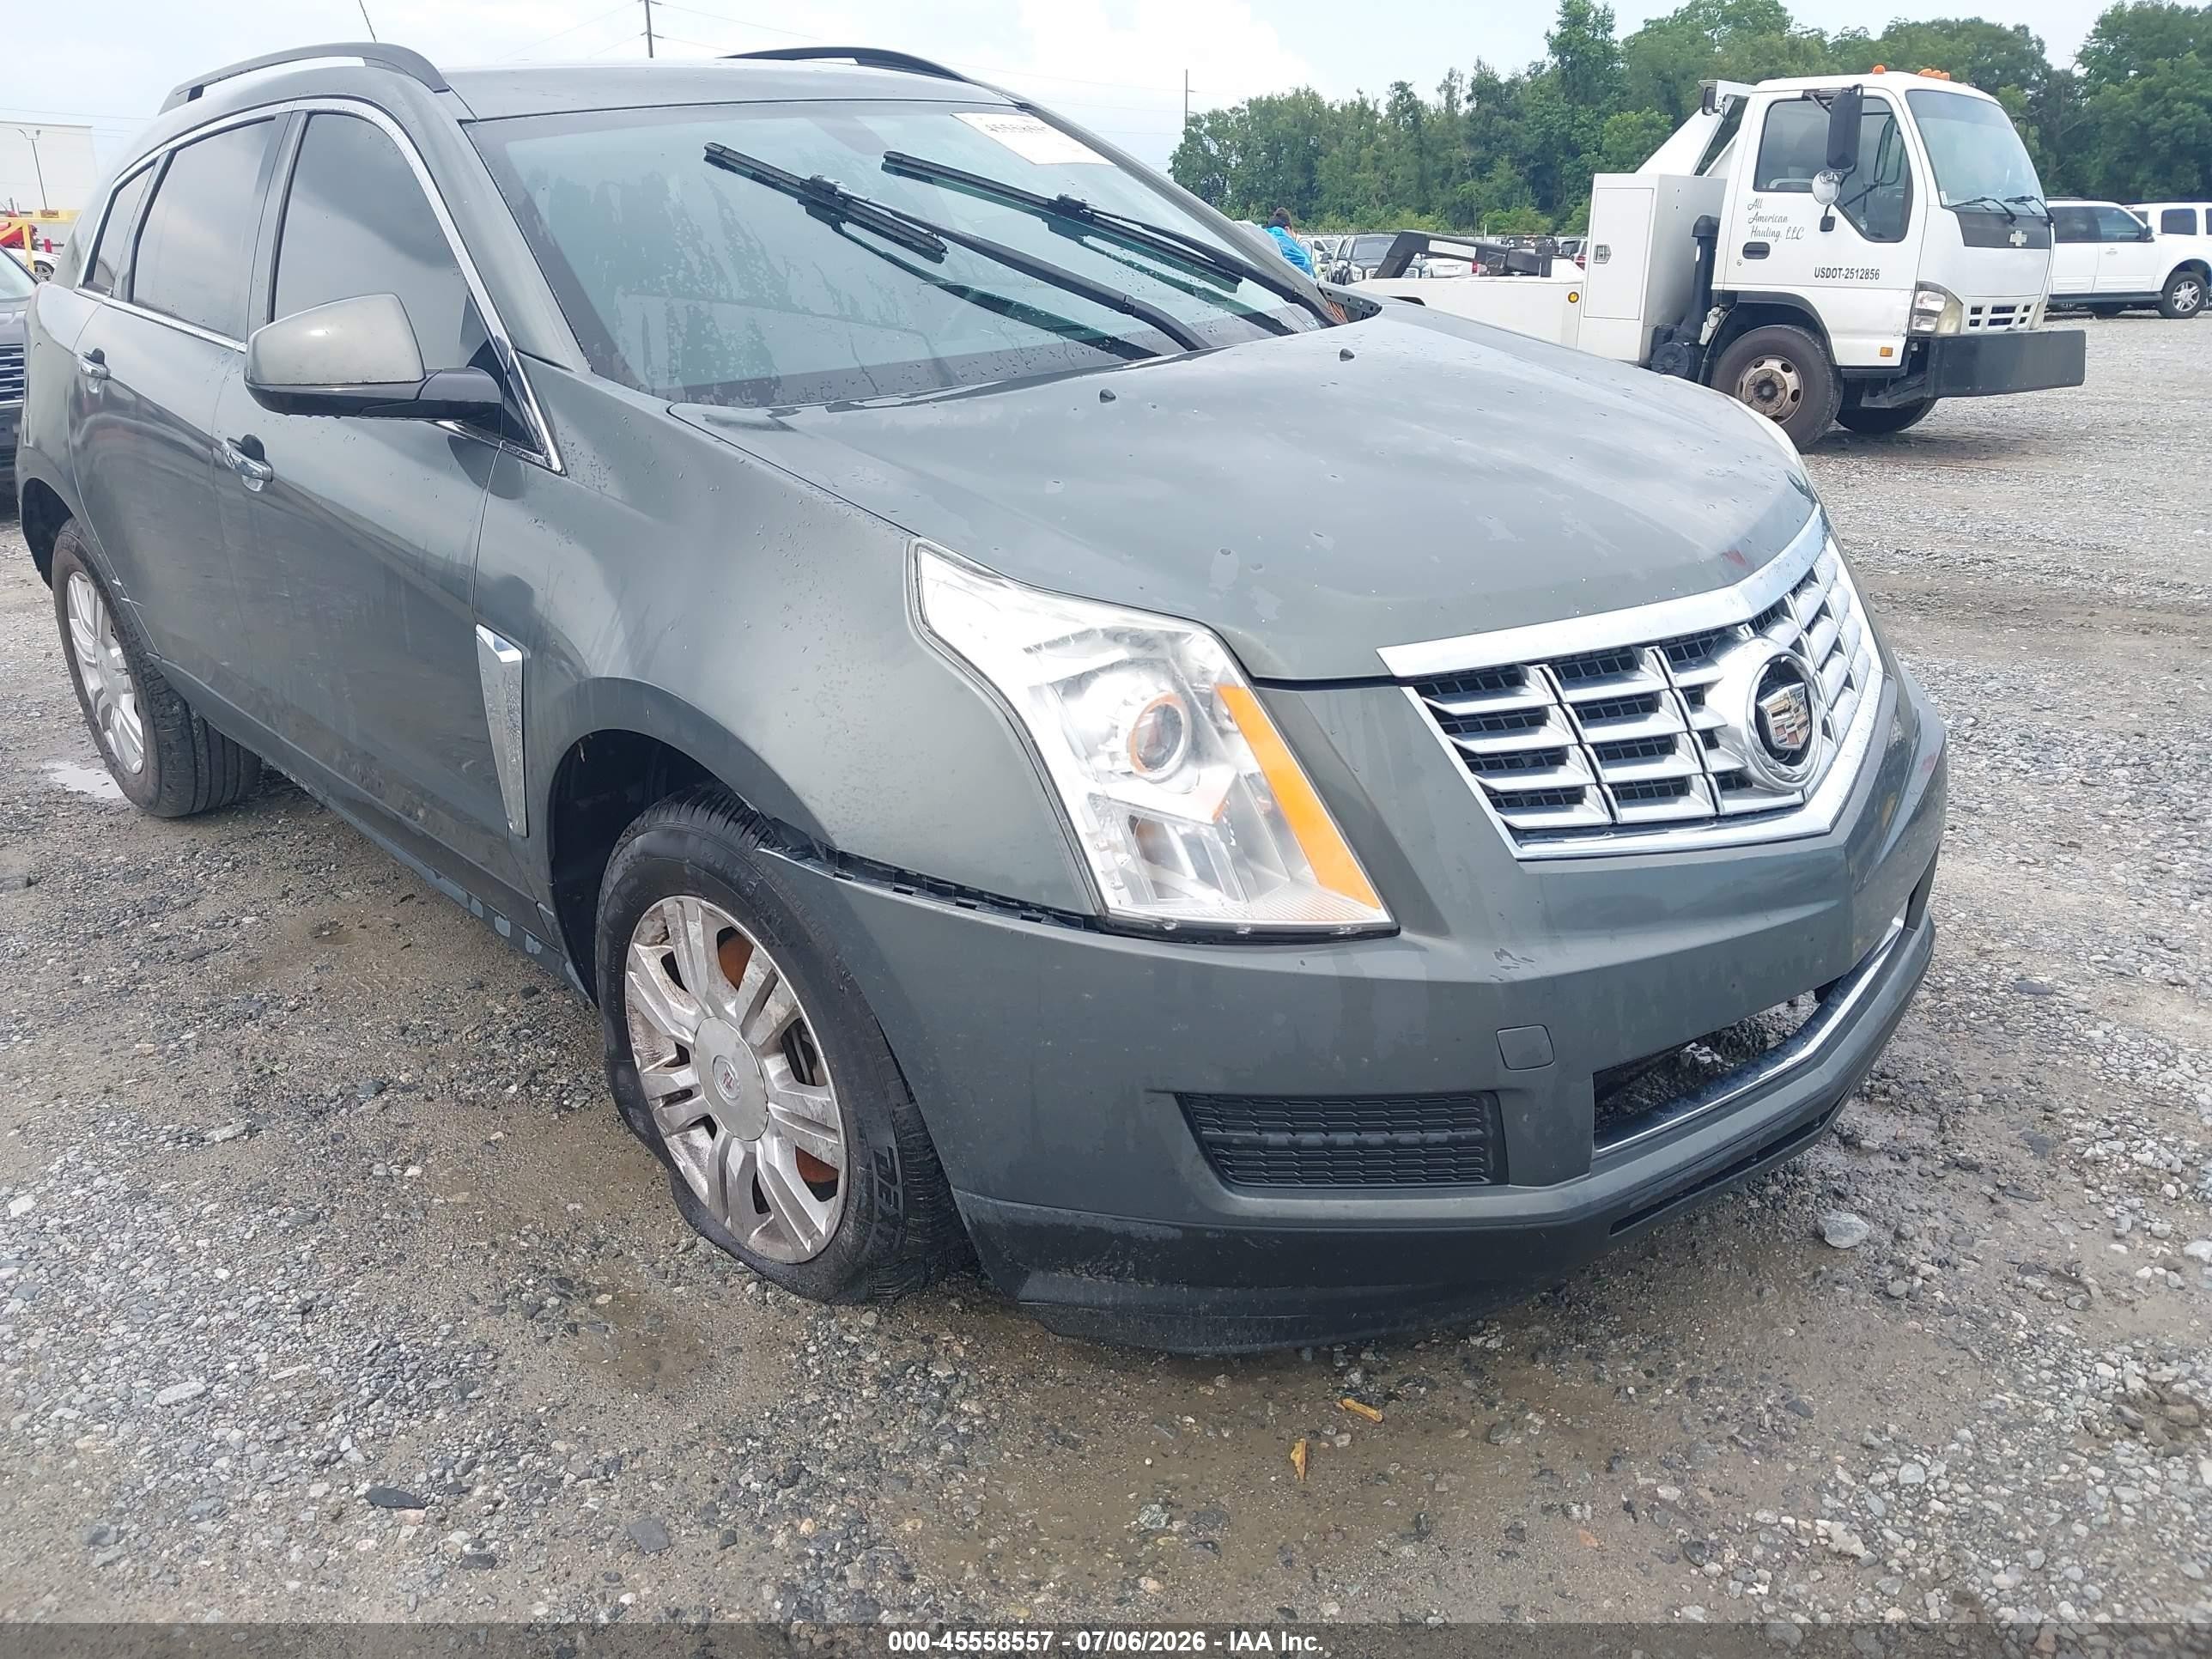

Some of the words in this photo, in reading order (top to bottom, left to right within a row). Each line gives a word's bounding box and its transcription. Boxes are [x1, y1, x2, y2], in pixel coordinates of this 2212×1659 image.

[1747, 198, 1764, 210] All
[1748, 211, 1788, 224] American
[1786, 226, 1805, 240] LLC
[1814, 266, 1881, 280] USDOT-2512856
